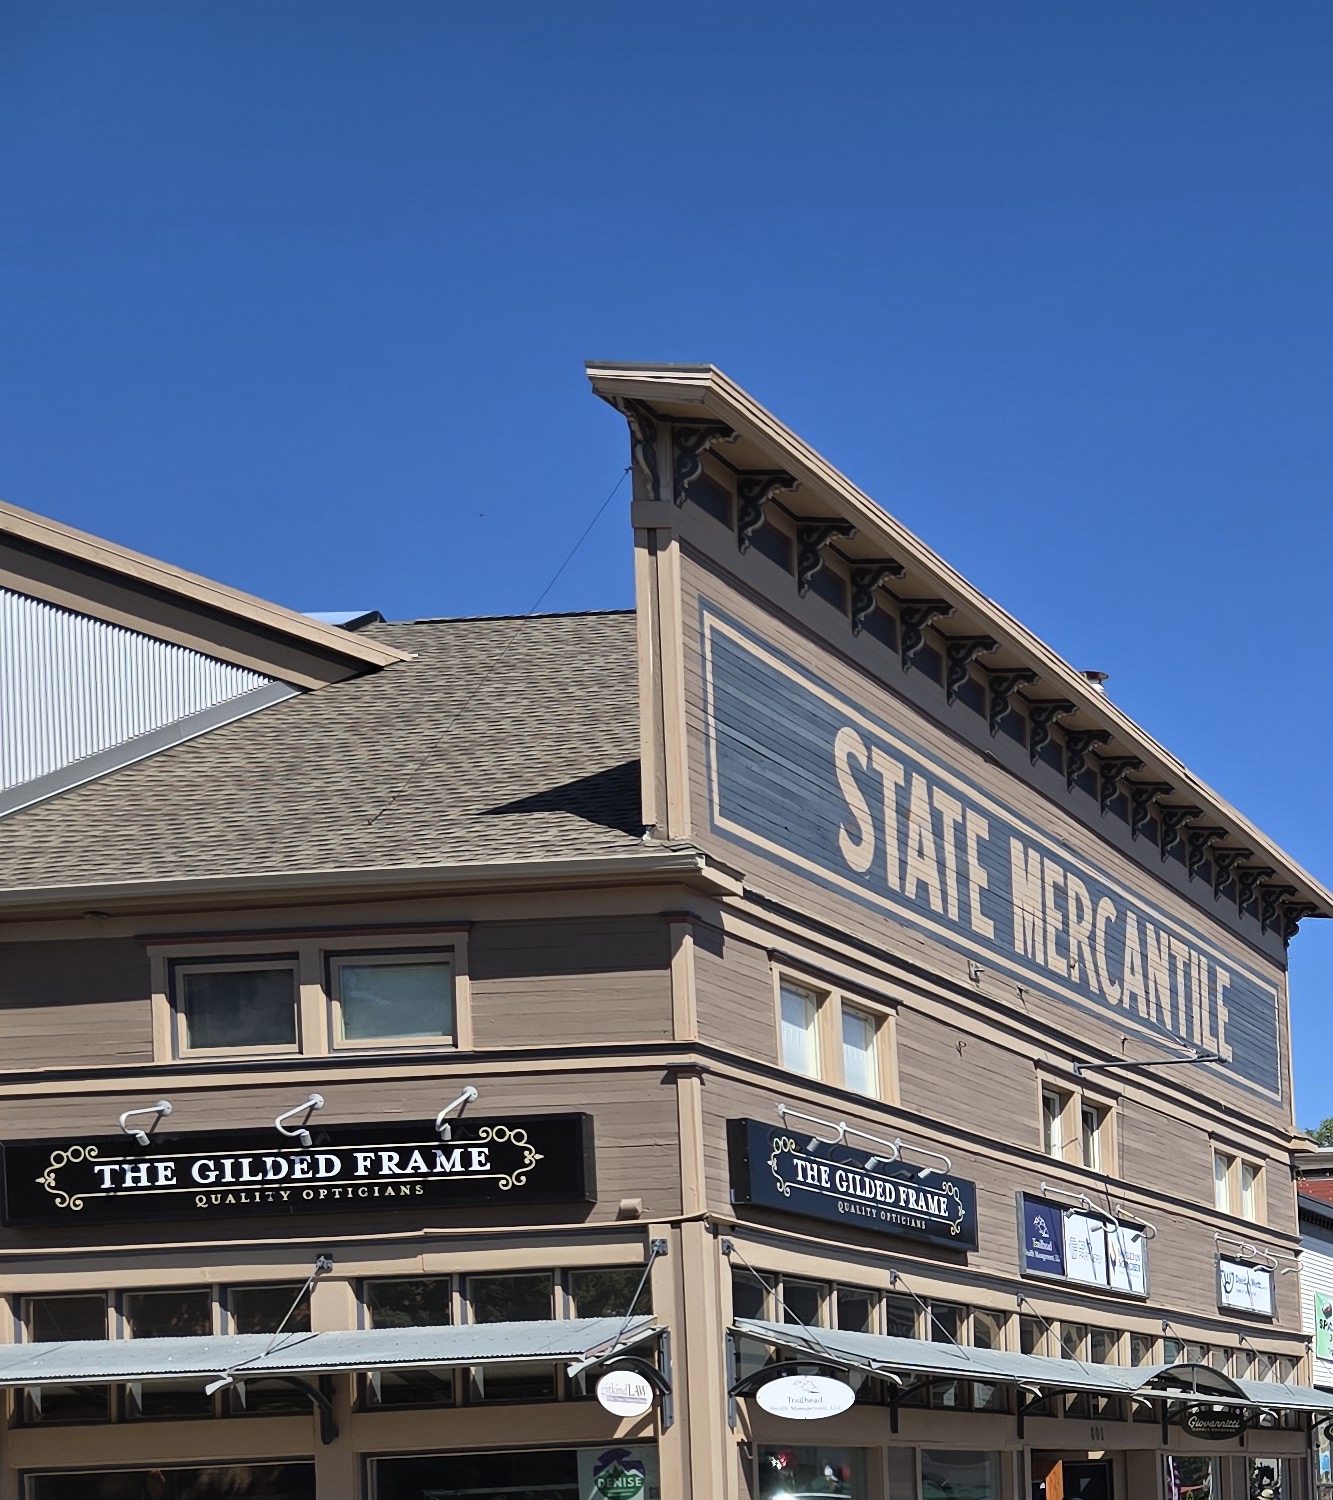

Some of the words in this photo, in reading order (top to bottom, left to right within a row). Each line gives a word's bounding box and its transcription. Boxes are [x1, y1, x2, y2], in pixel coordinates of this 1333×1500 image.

[834, 727, 996, 940] STATE
[1010, 836, 1233, 1063] MERCANTILE
[94, 1161, 177, 1189] THE
[191, 1154, 342, 1184] GILDED
[353, 1147, 491, 1176] FRAME
[195, 1191, 291, 1208] QUALITY
[303, 1185, 424, 1200] OPTICIANS
[793, 1158, 831, 1188] THE
[835, 1169, 896, 1203] GILDED
[898, 1185, 949, 1217] FRAME
[837, 1200, 877, 1218] QUALITY
[880, 1210, 926, 1230] OPTICIANS
[786, 1396, 823, 1404] Trailhead
[1187, 1415, 1241, 1429] Giovannitti
[597, 1477, 643, 1488] DENISE
